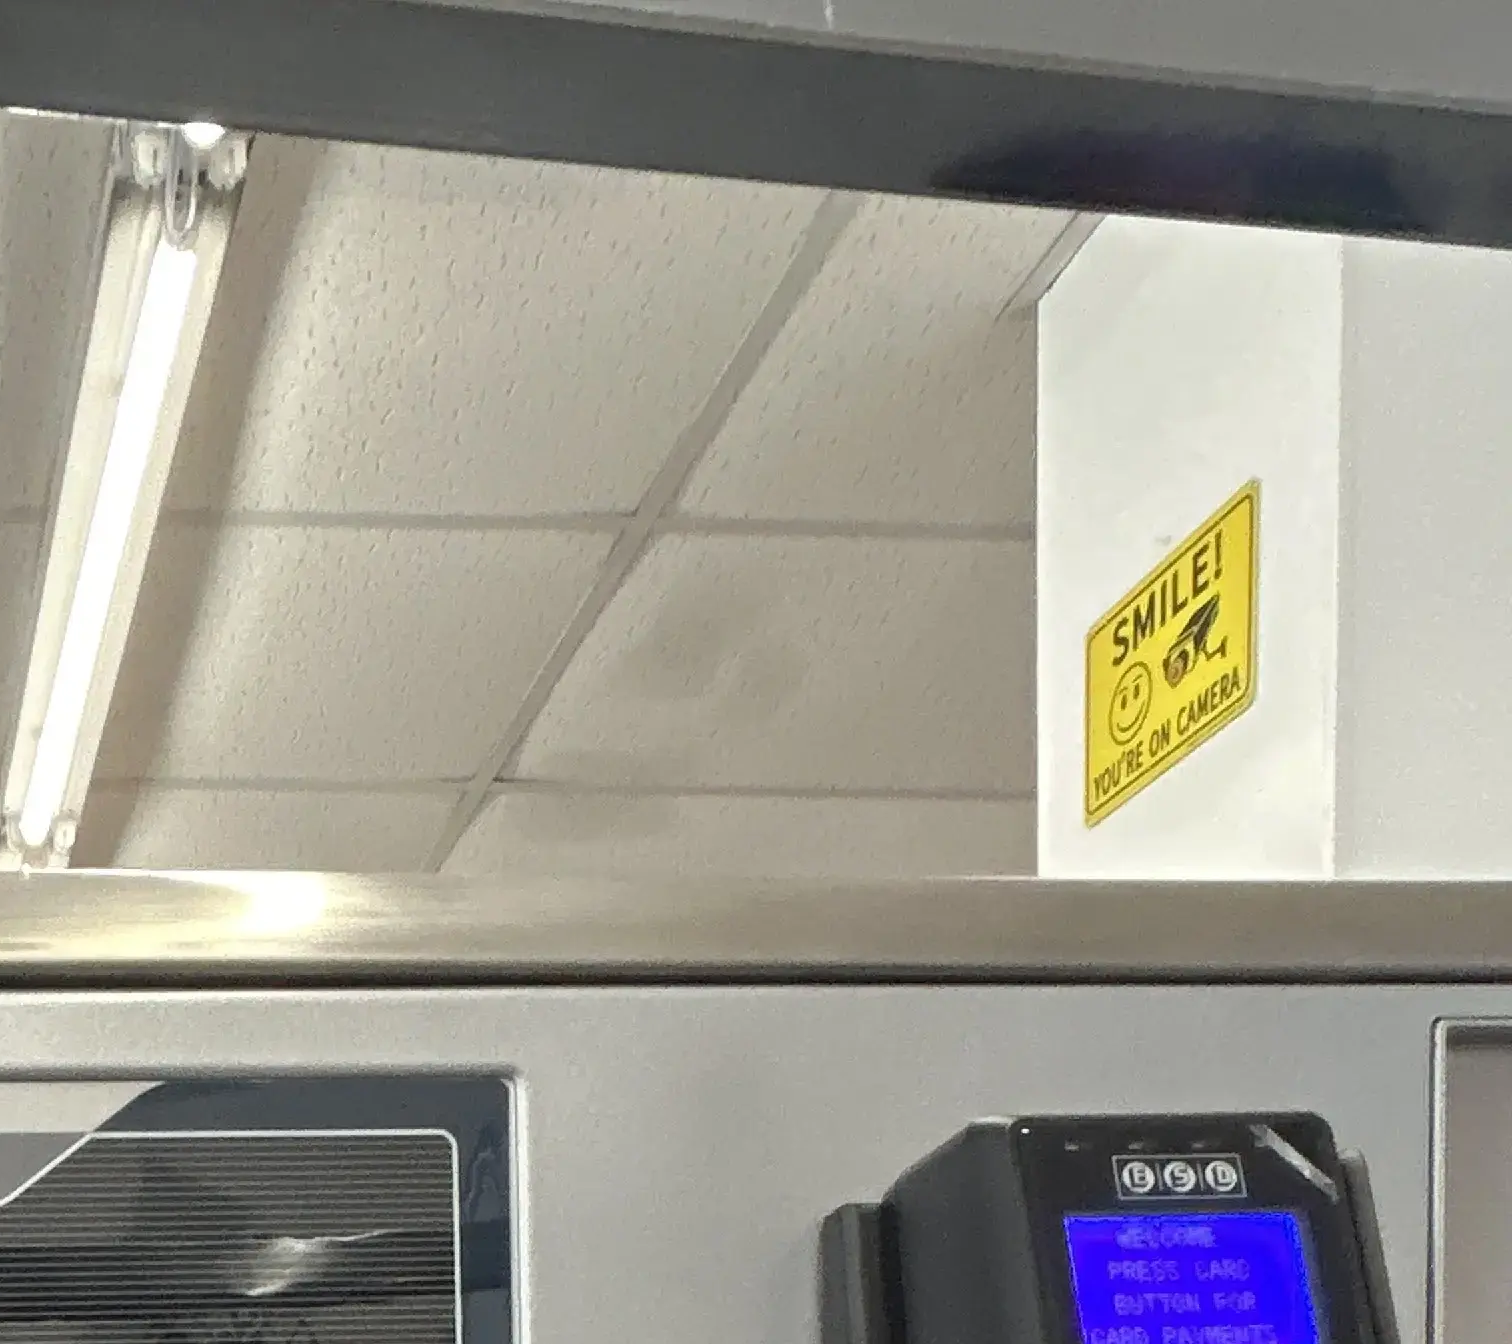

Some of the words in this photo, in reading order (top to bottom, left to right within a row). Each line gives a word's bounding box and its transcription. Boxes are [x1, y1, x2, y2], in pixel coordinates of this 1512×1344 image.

[1111, 529, 1223, 667] SMILE!
[1092, 748, 1144, 801] YOU'RE
[1148, 719, 1172, 758] ON
[1176, 666, 1242, 736] CAMERA
[1107, 1257, 1180, 1283] PRESS
[1114, 1291, 1201, 1316] BUTTON
